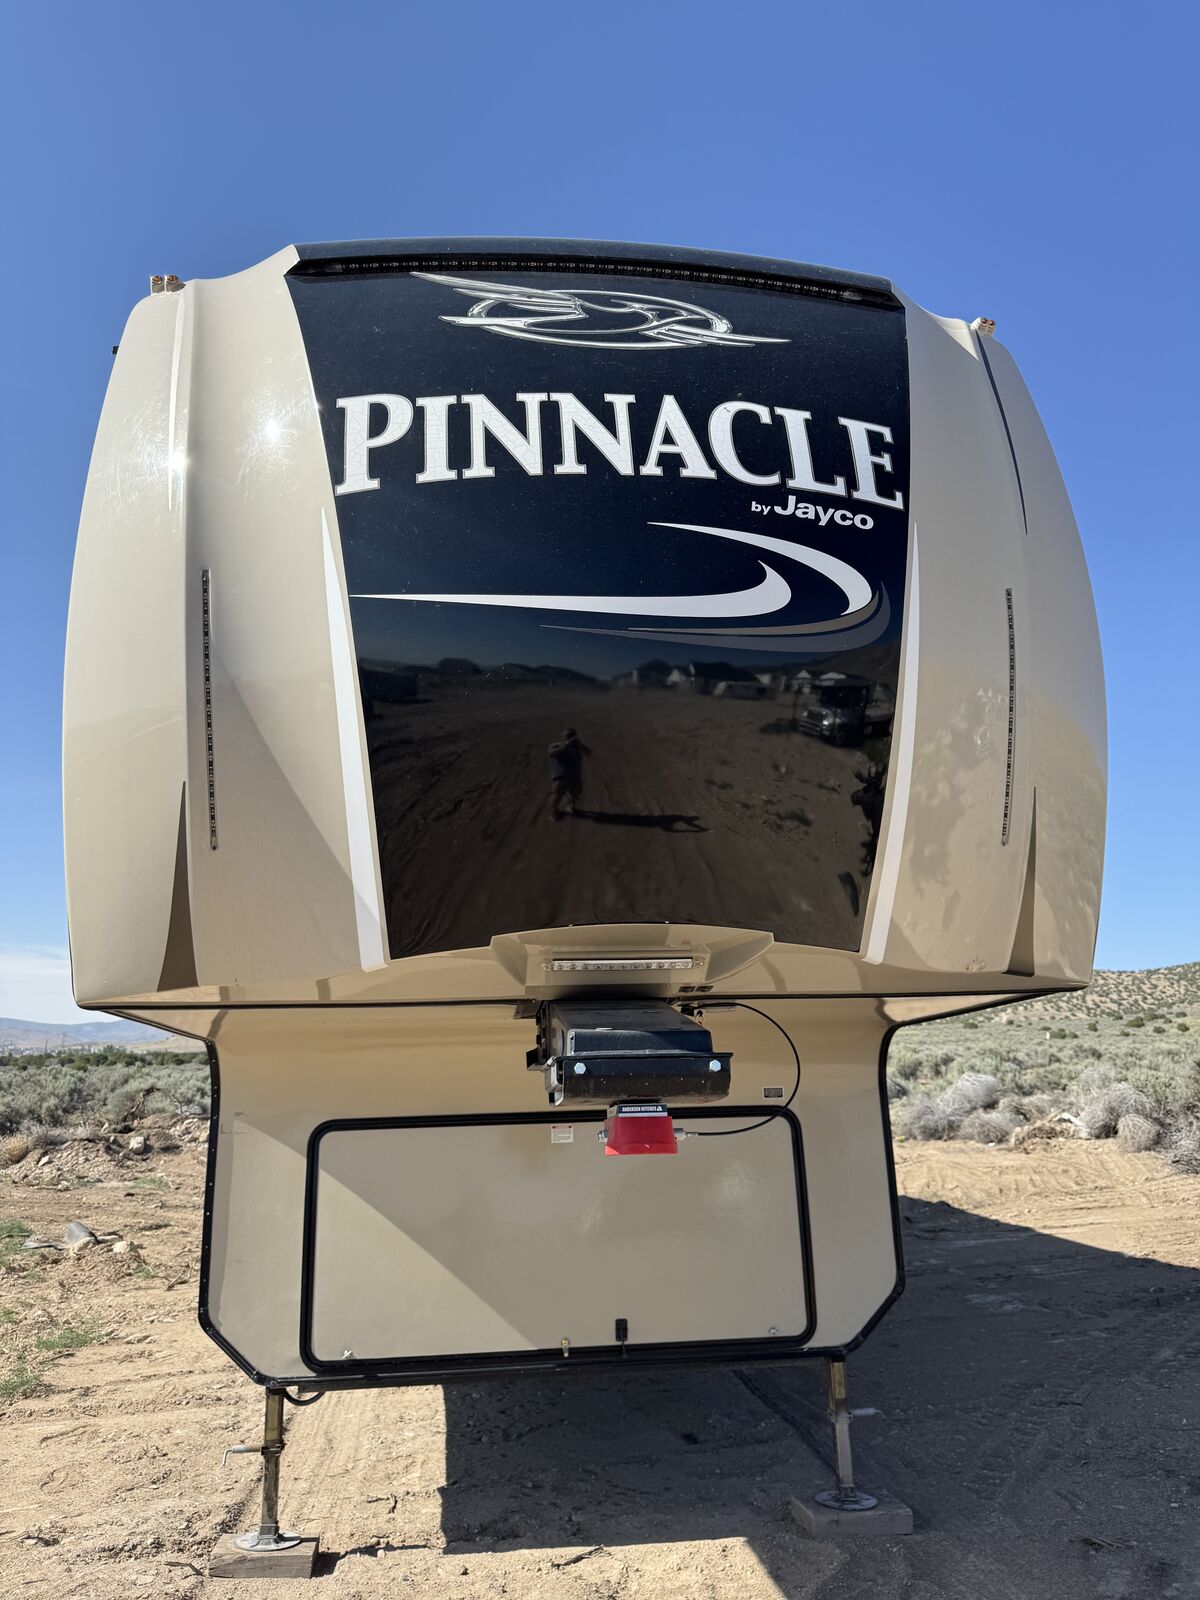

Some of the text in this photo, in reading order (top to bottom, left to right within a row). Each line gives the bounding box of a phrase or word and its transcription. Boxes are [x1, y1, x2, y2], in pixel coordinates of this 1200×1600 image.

[335, 392, 905, 511] PINNACLE
[751, 495, 874, 531] by Jayco
